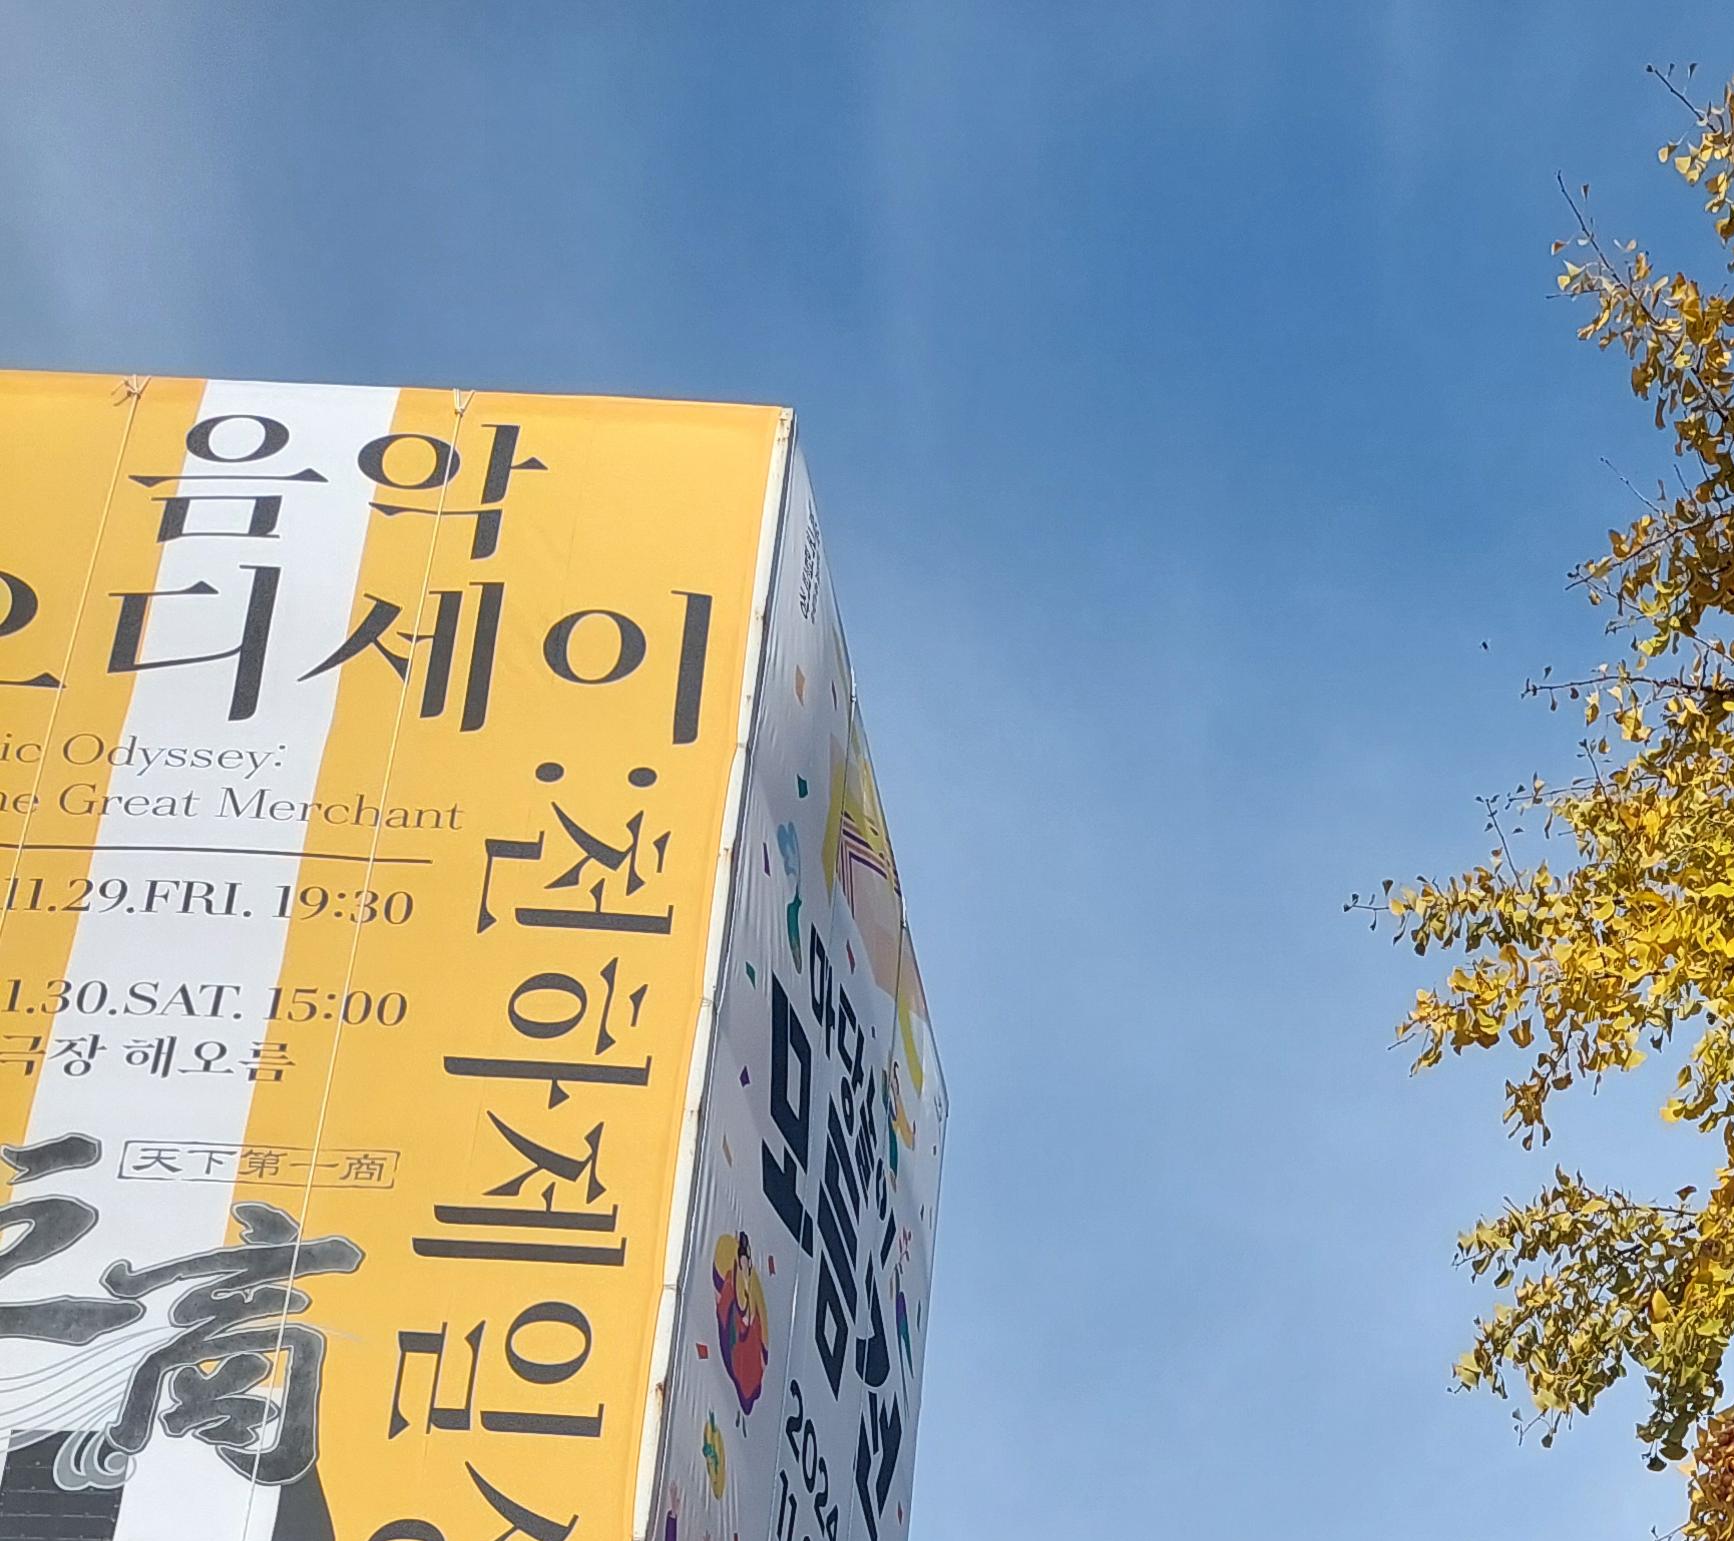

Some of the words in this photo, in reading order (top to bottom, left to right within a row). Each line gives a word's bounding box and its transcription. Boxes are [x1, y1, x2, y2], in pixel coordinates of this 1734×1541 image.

[128, 415, 549, 560] 음악
[62, 733, 287, 780] Odyssey:
[59, 783, 199, 817] Great
[215, 787, 465, 831] Merchant
[271, 884, 414, 925] 19:30
[262, 986, 408, 1027] 15:00
[124, 1035, 296, 1083] 해오름
[132, 1146, 387, 1183] 天下第一商
